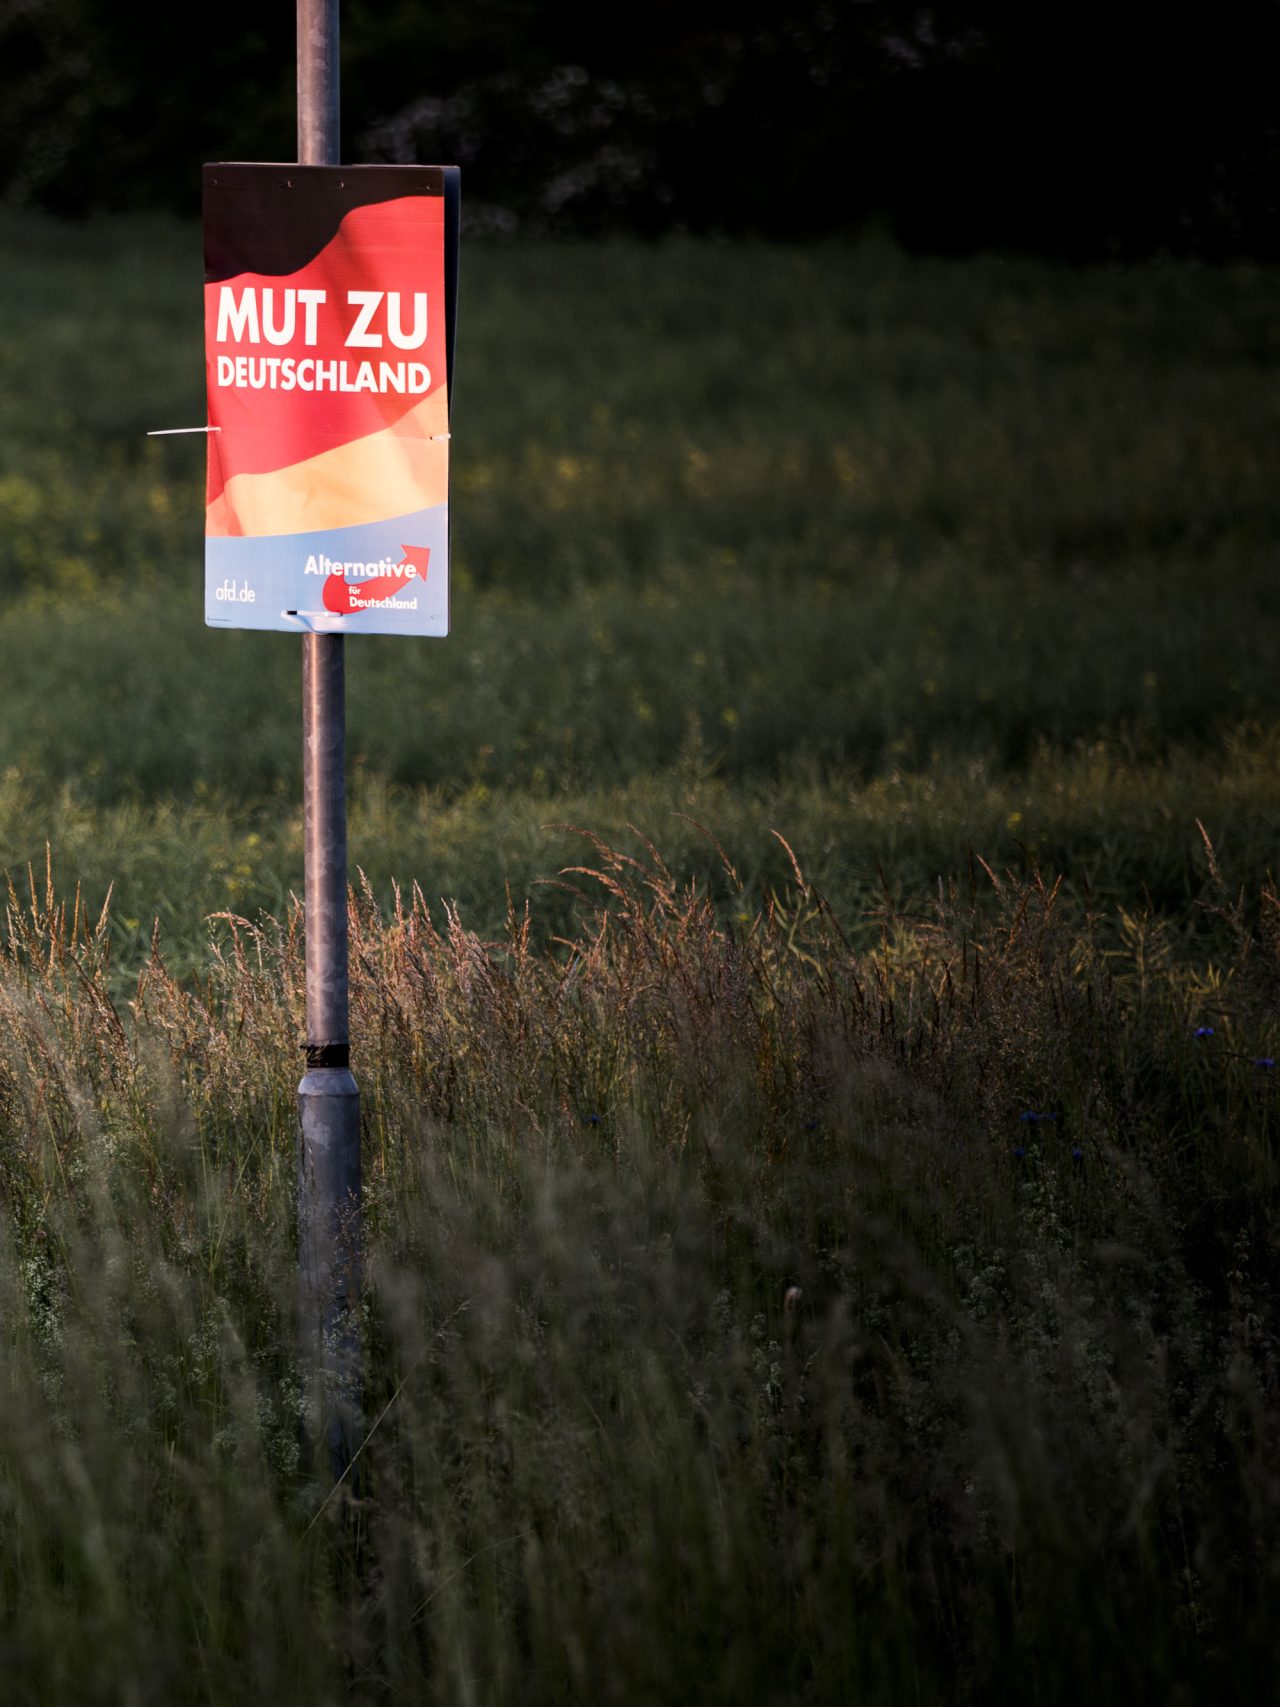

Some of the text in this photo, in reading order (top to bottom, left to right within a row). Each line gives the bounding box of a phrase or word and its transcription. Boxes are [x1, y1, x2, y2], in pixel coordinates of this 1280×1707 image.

[216, 286, 428, 350] MUT ZU
[217, 355, 432, 394] DEUTSCHLAND
[304, 554, 417, 578] Alternative
[215, 579, 256, 603] afd.de
[348, 585, 361, 596] für
[349, 596, 418, 610] Deutschland
